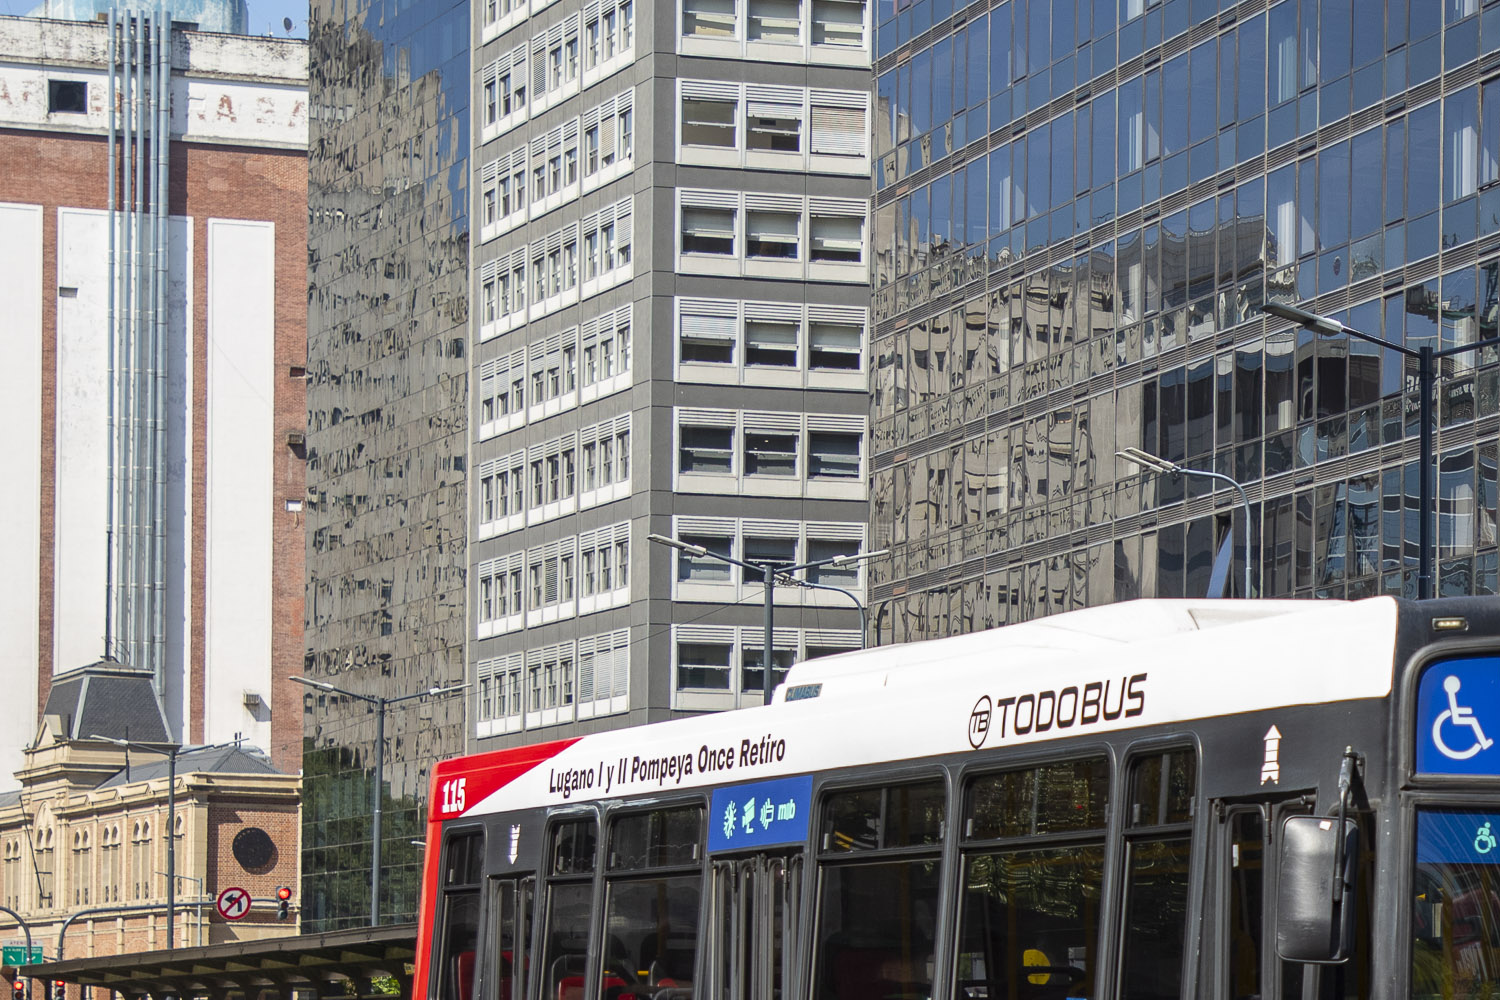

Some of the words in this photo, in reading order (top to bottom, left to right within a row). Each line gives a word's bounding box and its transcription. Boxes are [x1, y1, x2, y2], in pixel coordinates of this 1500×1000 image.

[997, 672, 1148, 738] TODOBUS
[442, 777, 467, 814] 115
[549, 765, 595, 800] Lugano
[605, 768, 615, 794] y
[630, 750, 694, 785] Pompeya
[698, 742, 736, 774] Once
[738, 734, 786, 769] Retiro
